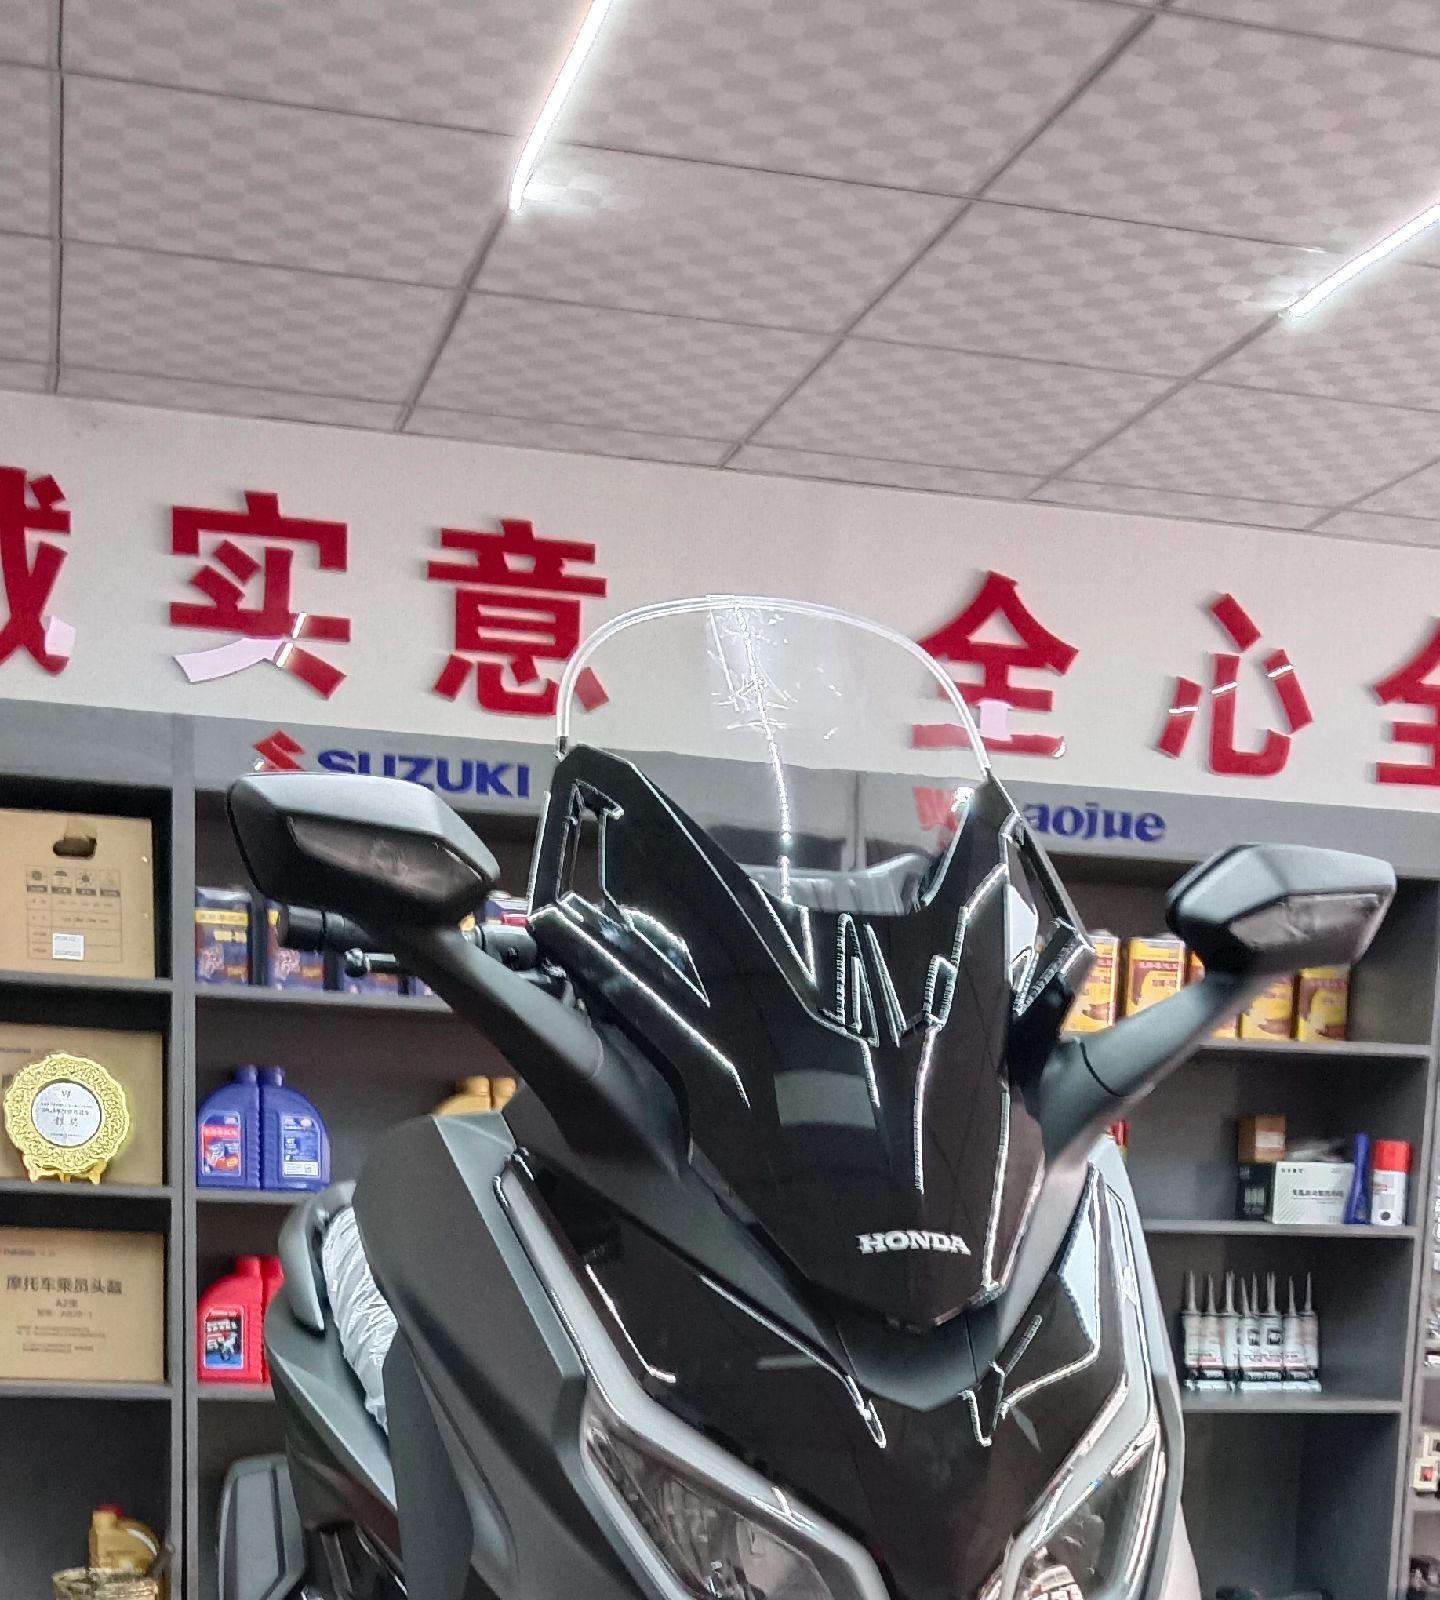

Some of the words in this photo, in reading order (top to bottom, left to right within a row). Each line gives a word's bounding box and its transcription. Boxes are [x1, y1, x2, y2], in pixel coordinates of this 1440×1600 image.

[317, 749, 530, 798] SUZUKI
[1022, 801, 1167, 843] aojue
[855, 1230, 971, 1256] HONDA
